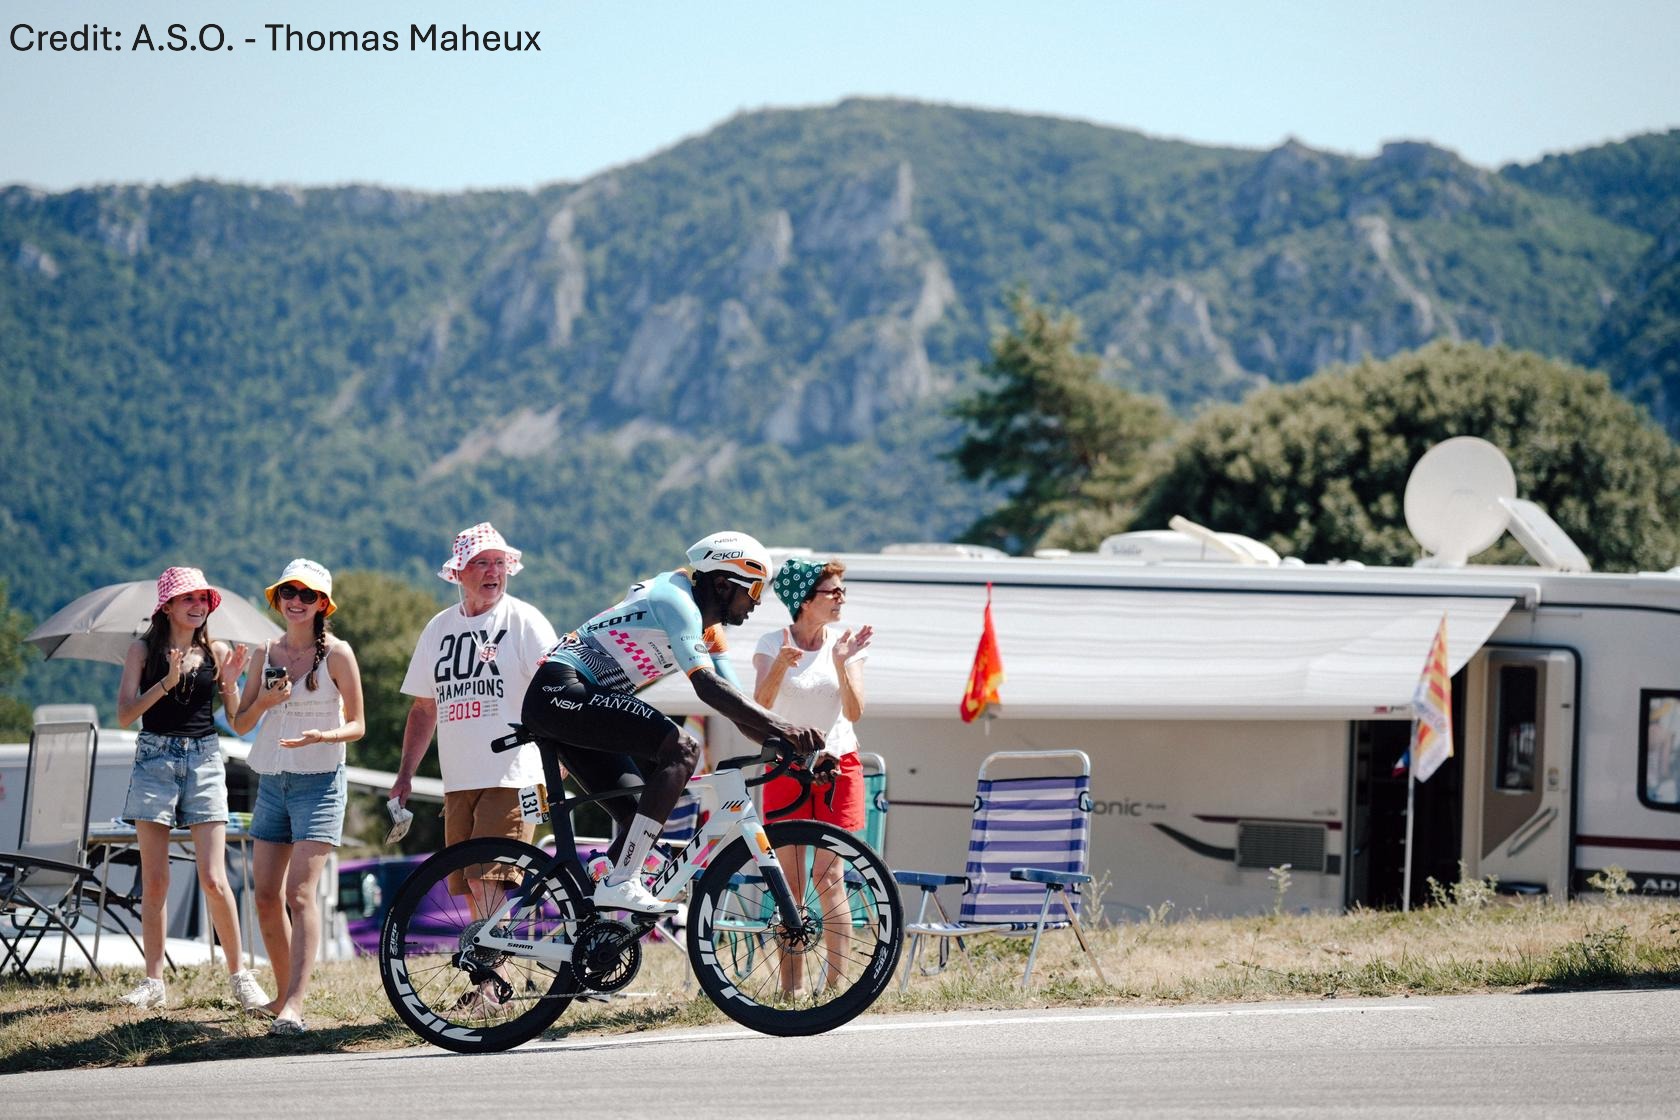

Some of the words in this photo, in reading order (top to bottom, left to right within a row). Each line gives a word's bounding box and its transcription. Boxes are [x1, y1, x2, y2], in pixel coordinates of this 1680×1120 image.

[587, 610, 647, 633] SCOTT
[434, 629, 508, 683] 20X
[448, 701, 481, 722] 2019
[550, 697, 584, 711] NSN
[588, 694, 655, 719] FANTINI
[521, 791, 539, 817] 131
[1090, 797, 1142, 816] onic
[651, 829, 703, 898] COTT
[1641, 878, 1680, 894] AD
[507, 942, 534, 950] SRAM
